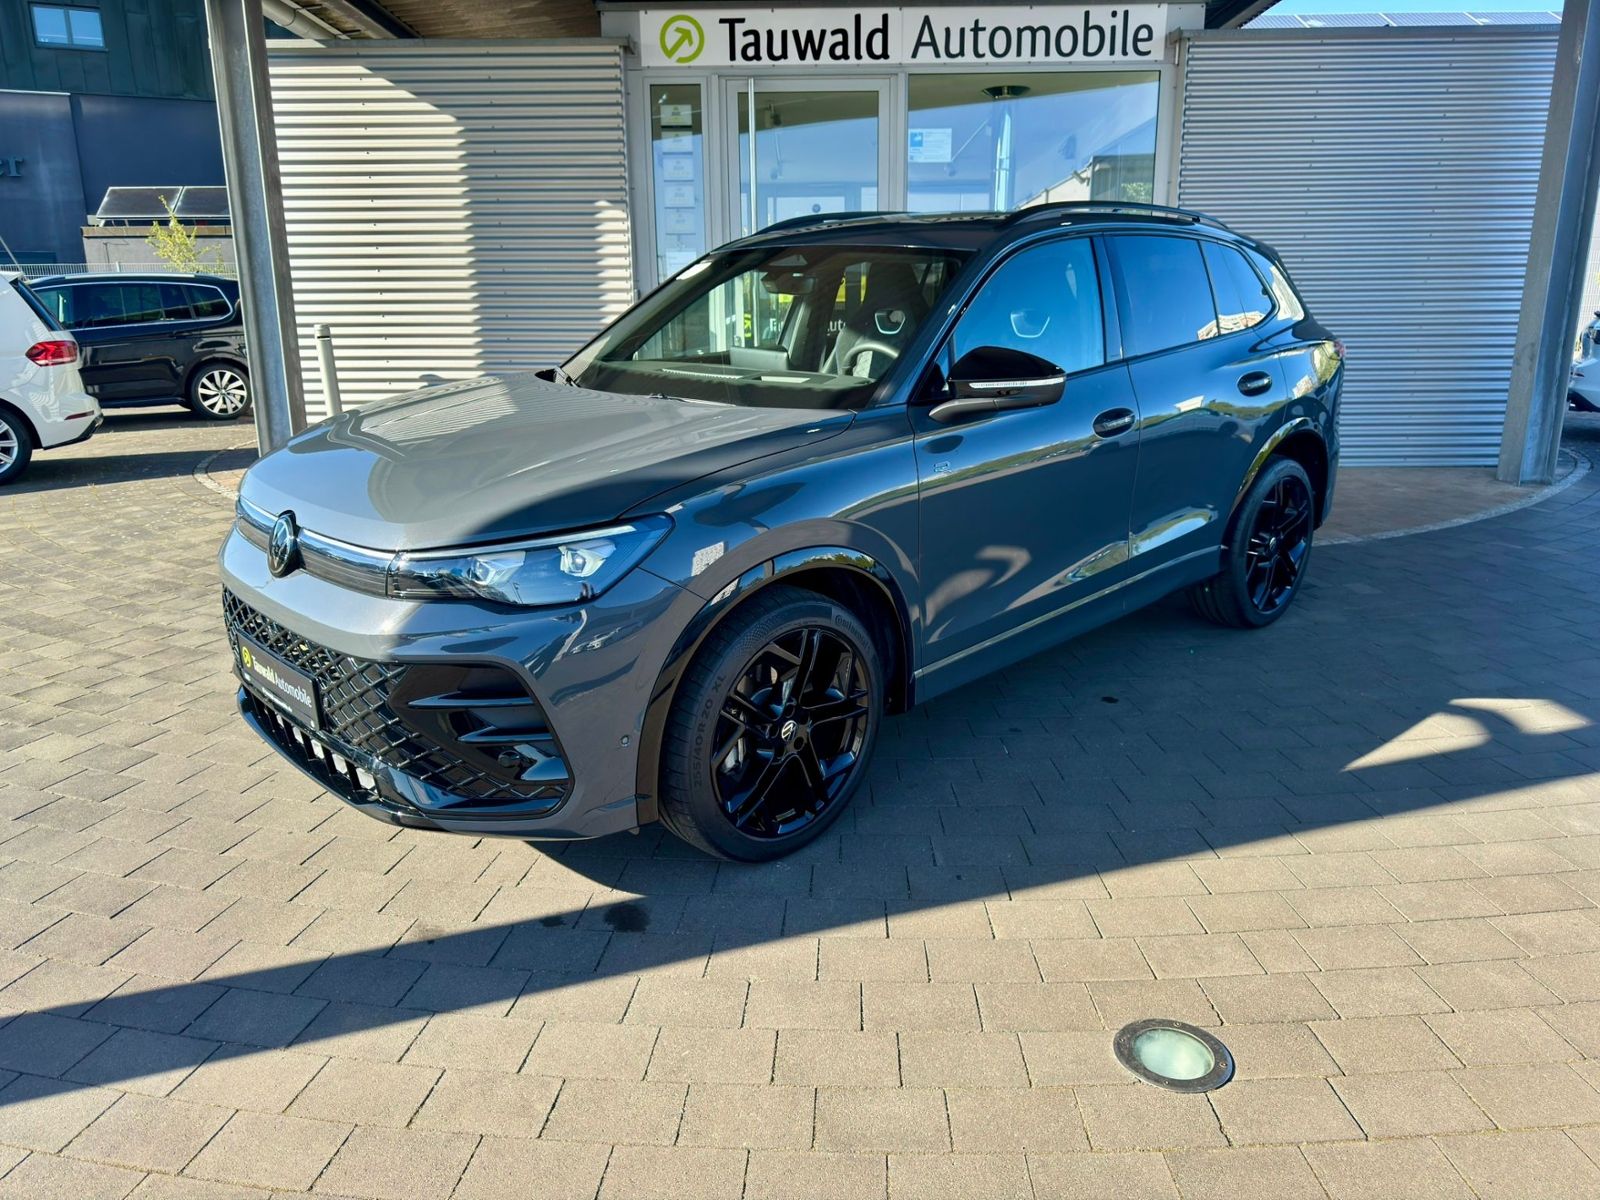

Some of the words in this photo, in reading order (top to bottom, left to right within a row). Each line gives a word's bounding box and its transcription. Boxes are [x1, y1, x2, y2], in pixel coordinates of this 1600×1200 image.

[719, 13, 890, 61] Tauwald
[911, 10, 1153, 60] Automobile
[275, 672, 312, 708] Automobile
[712, 675, 727, 692] XL
